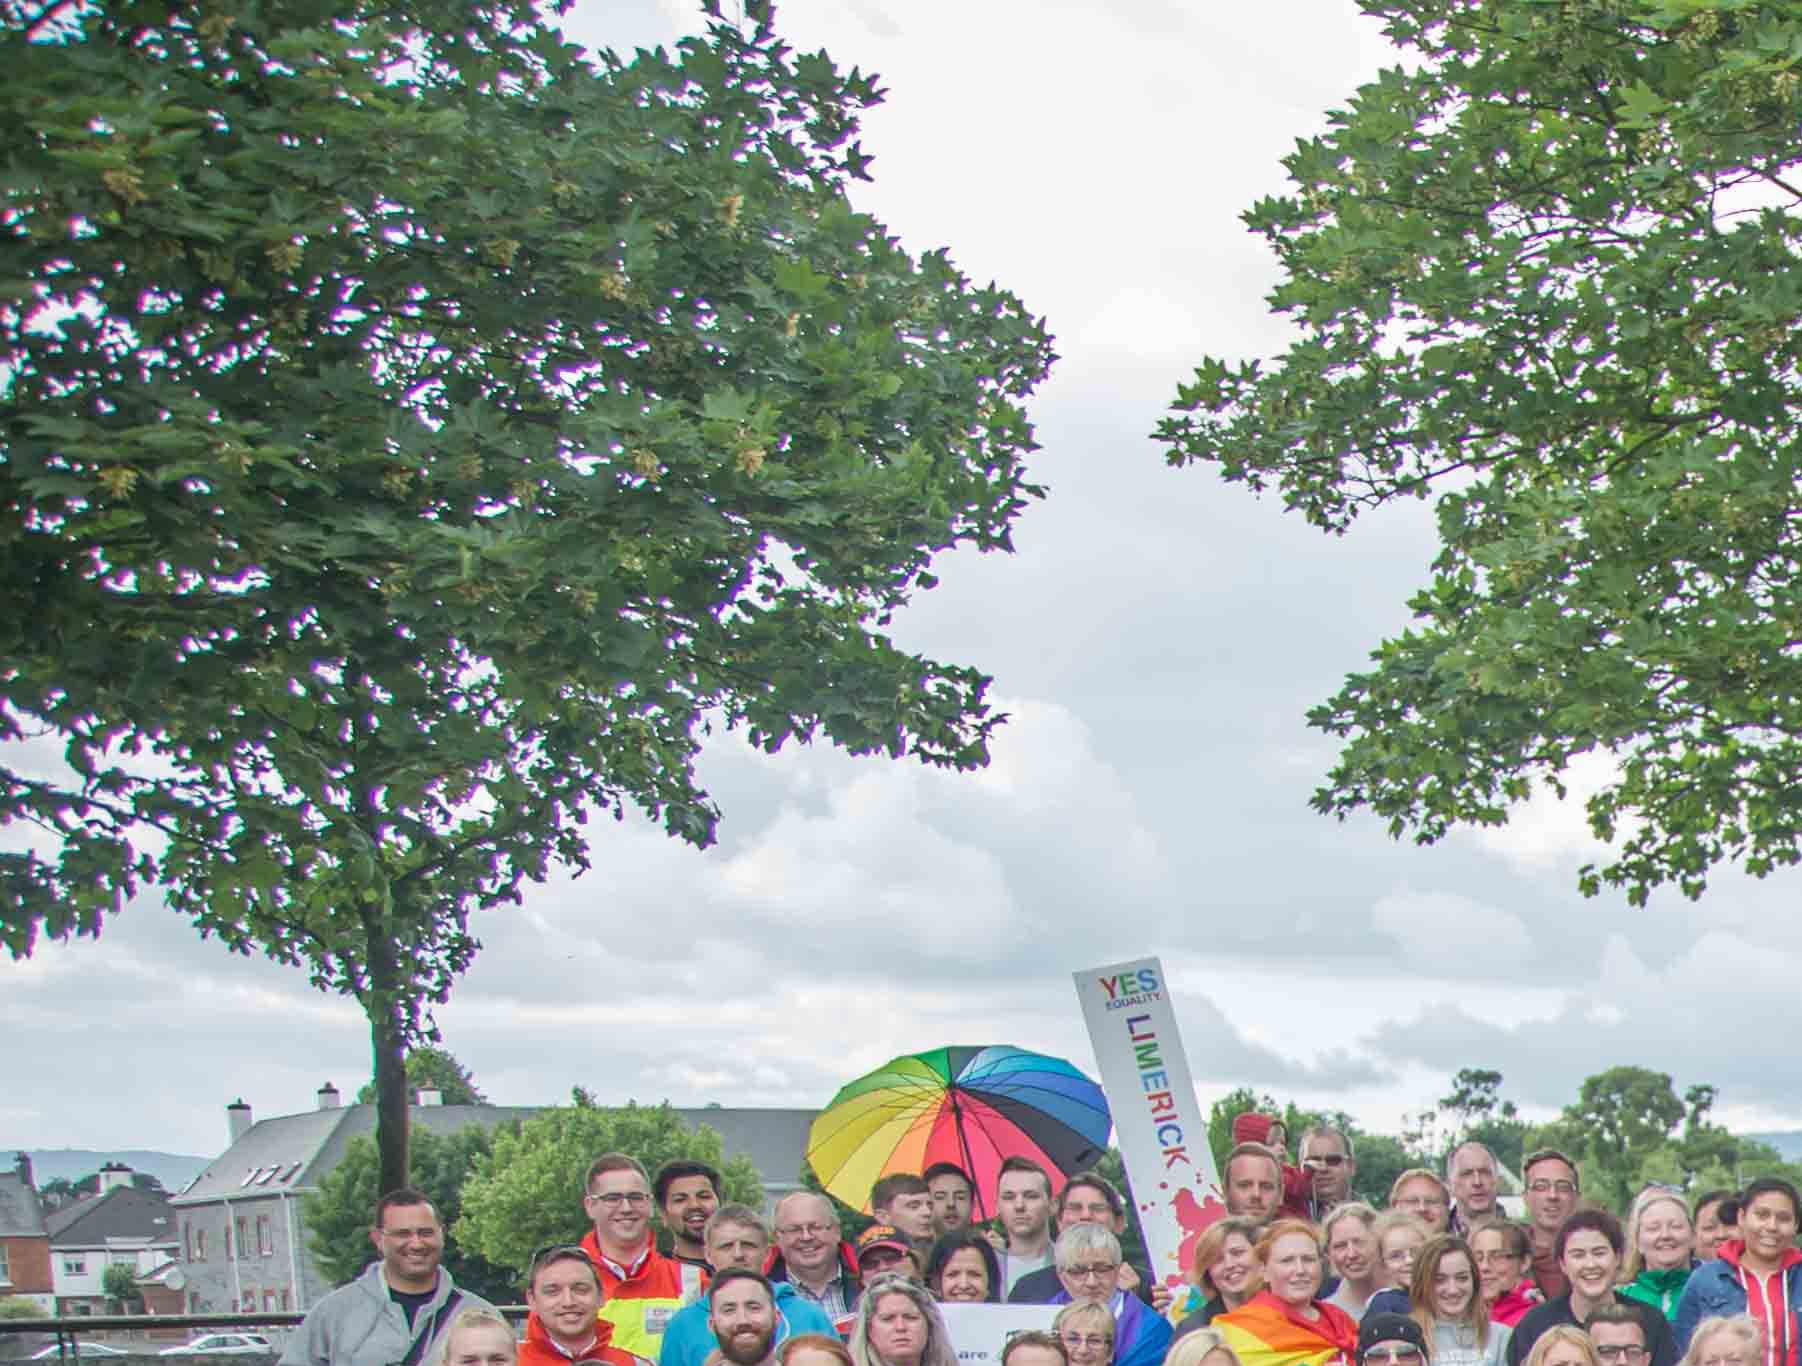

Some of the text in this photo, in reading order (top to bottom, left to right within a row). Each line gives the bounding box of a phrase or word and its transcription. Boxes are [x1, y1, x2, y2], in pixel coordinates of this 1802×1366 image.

[1099, 968, 1159, 1000] YES
[1105, 991, 1161, 1011] EQUALITY
[1126, 1014, 1191, 1168] LIMERICK
